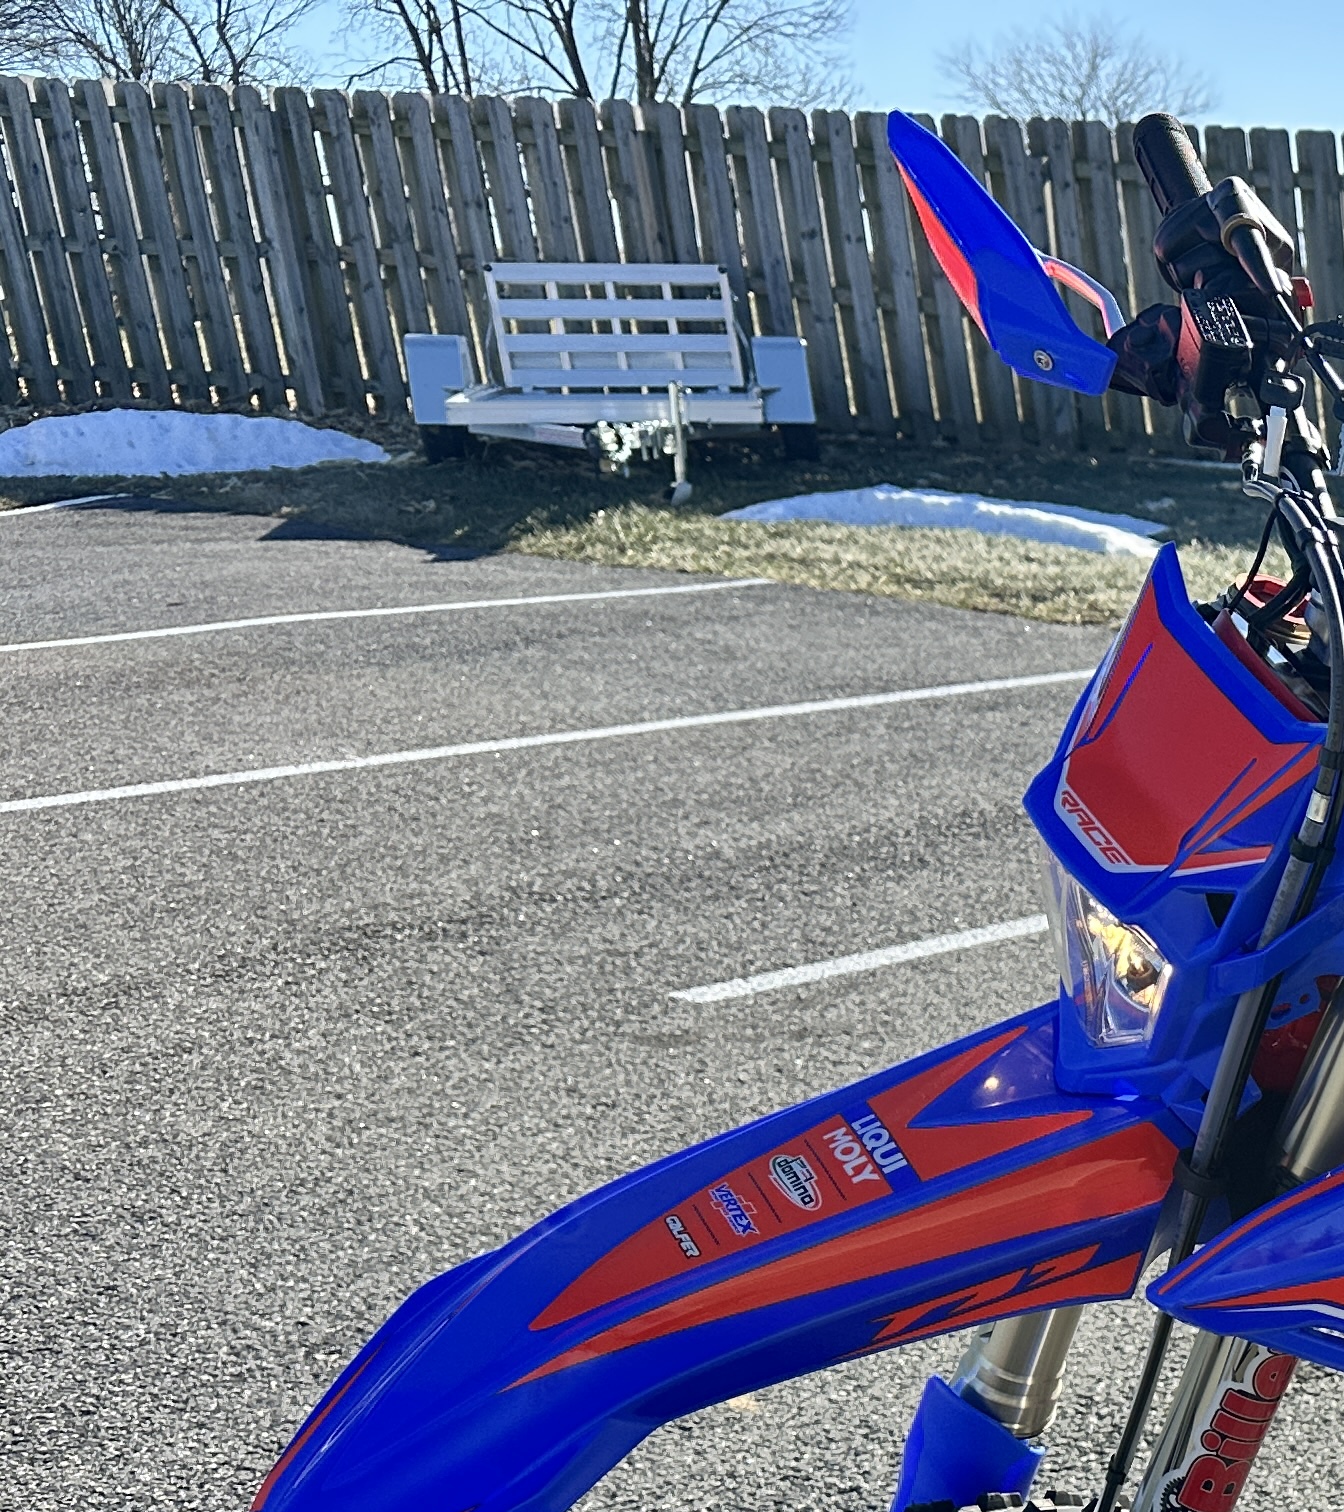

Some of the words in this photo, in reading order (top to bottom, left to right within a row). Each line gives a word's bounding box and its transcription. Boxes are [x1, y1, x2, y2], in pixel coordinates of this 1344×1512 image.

[1061, 790, 1131, 865] RACE
[822, 1127, 881, 1184] MOLY
[851, 1113, 908, 1175] LIQUI
[712, 1183, 756, 1236] VERTEX
[776, 1156, 815, 1208] domino
[665, 1214, 700, 1258] GALFER
